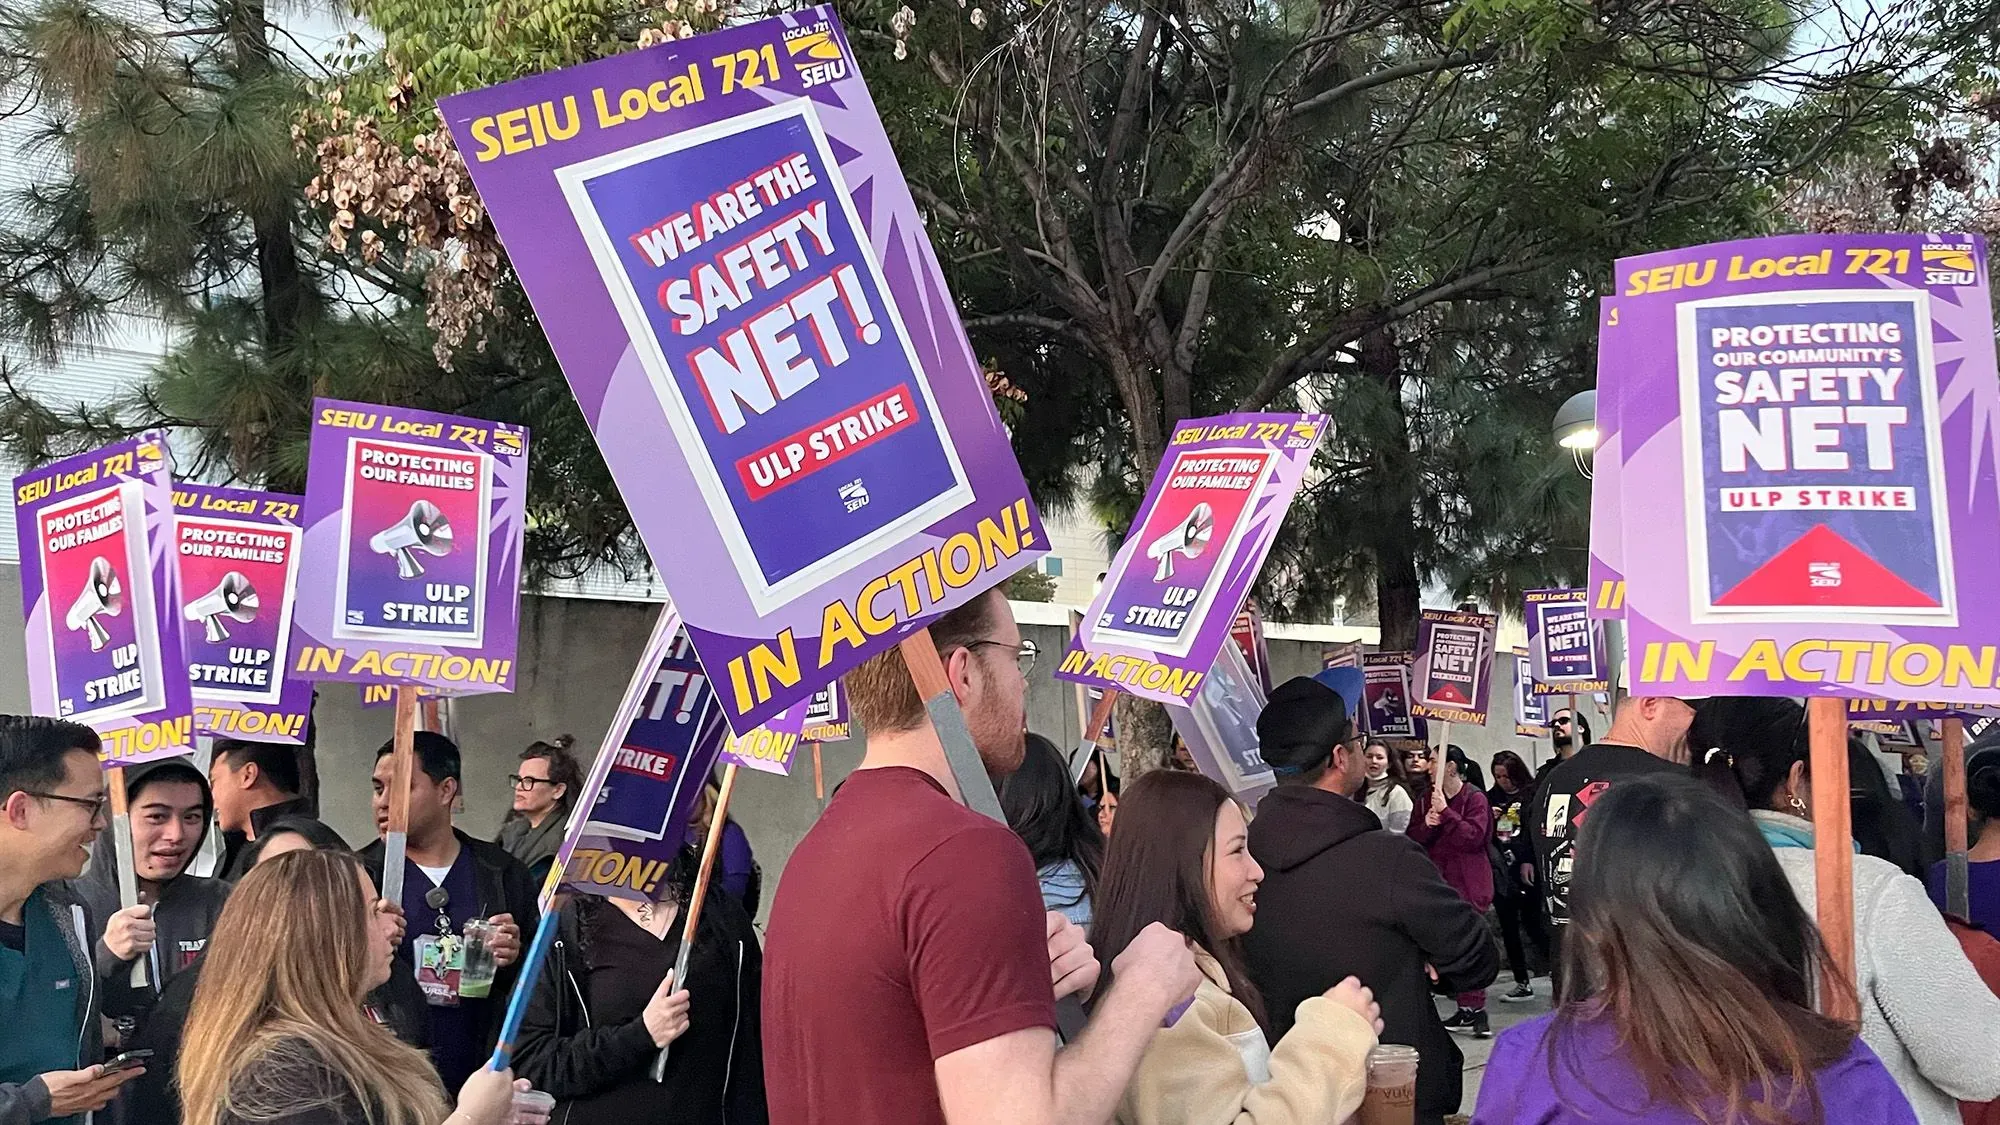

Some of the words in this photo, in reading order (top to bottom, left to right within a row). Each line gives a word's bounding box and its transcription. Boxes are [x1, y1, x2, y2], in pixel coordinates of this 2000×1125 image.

[782, 26, 812, 41] LOCAL
[813, 22, 830, 33] 721
[801, 59, 846, 89] SEIU
[470, 95, 581, 162] SEIU
[592, 63, 704, 128] Local
[712, 43, 780, 95] 721
[630, 213, 701, 268] WE
[694, 181, 762, 243] ARE
[753, 153, 817, 206] THE
[1922, 244, 1954, 252] LOCAL
[1956, 243, 1973, 251] 721
[659, 201, 835, 335] SAFETY
[1625, 259, 1717, 297] SEIU
[1726, 250, 1832, 281] Local
[1844, 248, 1910, 275] 721
[1923, 272, 1975, 285] SEIU
[1711, 322, 1902, 349] PROTECTING
[688, 264, 882, 434] NET!
[1712, 352, 1758, 367] OUR
[1758, 348, 1903, 366] COMMUNITY'S
[1714, 367, 1905, 405] SAFETY
[318, 409, 377, 430] SEIU
[381, 416, 444, 439] Local
[449, 425, 487, 445] 721
[1172, 426, 1209, 446] SEIU
[1206, 422, 1252, 442] Local
[1251, 423, 1288, 441] 721
[493, 446, 521, 456] SEIU
[749, 443, 805, 487] ULP
[808, 394, 909, 461] STRIKE
[1284, 439, 1311, 448] SEIU
[1718, 406, 1908, 473] NET
[361, 448, 475, 475] PROTECTING
[1178, 459, 1261, 473] PROTECTING
[17, 476, 51, 506] SEIU
[55, 462, 98, 492] Local
[103, 452, 133, 478] 721
[360, 467, 398, 483] OUR
[399, 471, 474, 491] FAMILIES
[1172, 476, 1199, 489] OUR
[1198, 476, 1253, 490] FAMILIES
[170, 491, 198, 507] IU
[201, 494, 257, 514] Local
[262, 501, 299, 519] 721
[846, 495, 870, 513] SEIU
[1729, 491, 1783, 508] ULP
[1797, 490, 1908, 507] STRIKE
[49, 530, 77, 553] OUR
[76, 516, 123, 546] FAMILIES
[181, 527, 287, 550] PROTECTING
[180, 543, 213, 557] OUR
[214, 545, 284, 564] FAMILIES
[426, 583, 471, 603] ULP
[1809, 579, 1842, 588] SEIU
[727, 626, 801, 716] IN
[818, 498, 1035, 669] ACTION!
[1163, 586, 1198, 607] ULP
[1526, 593, 1546, 602] SEIU
[1548, 593, 1570, 601] Local
[1572, 592, 1586, 601] 721
[383, 602, 469, 625] STRIKE
[1124, 605, 1187, 629] STRIKE
[1423, 612, 1442, 621] SEIU
[1444, 613, 1466, 623] Local
[1467, 616, 1482, 625] 721
[1436, 632, 1477, 642] PROTECTING
[1547, 620, 1586, 635] SAFETY
[1435, 644, 1475, 656] SAFETY
[1548, 631, 1588, 652] NET!
[112, 643, 138, 669] ULP
[229, 647, 270, 666] ULP
[296, 647, 344, 673] IN
[348, 651, 512, 684] ACTION!
[1433, 653, 1474, 673] NET
[1639, 641, 1716, 683] IN
[189, 663, 268, 686] STRIKE
[1058, 650, 1092, 675] IN
[1084, 653, 1204, 697] ACTION!
[84, 669, 141, 702] STRIKE
[364, 684, 393, 704] IN
[634, 669, 705, 724] T!
[815, 691, 828, 702] ULP
[1534, 684, 1547, 694] IN
[1552, 681, 1608, 693] ACTION!
[194, 707, 305, 737] TION!
[1411, 705, 1426, 715] IN
[1427, 708, 1485, 723] ACTION!
[97, 716, 192, 761] TION!
[801, 722, 848, 741] ACTION!
[724, 729, 797, 764] CTION!
[615, 748, 669, 775] TRIKE
[562, 849, 669, 893] TION!
